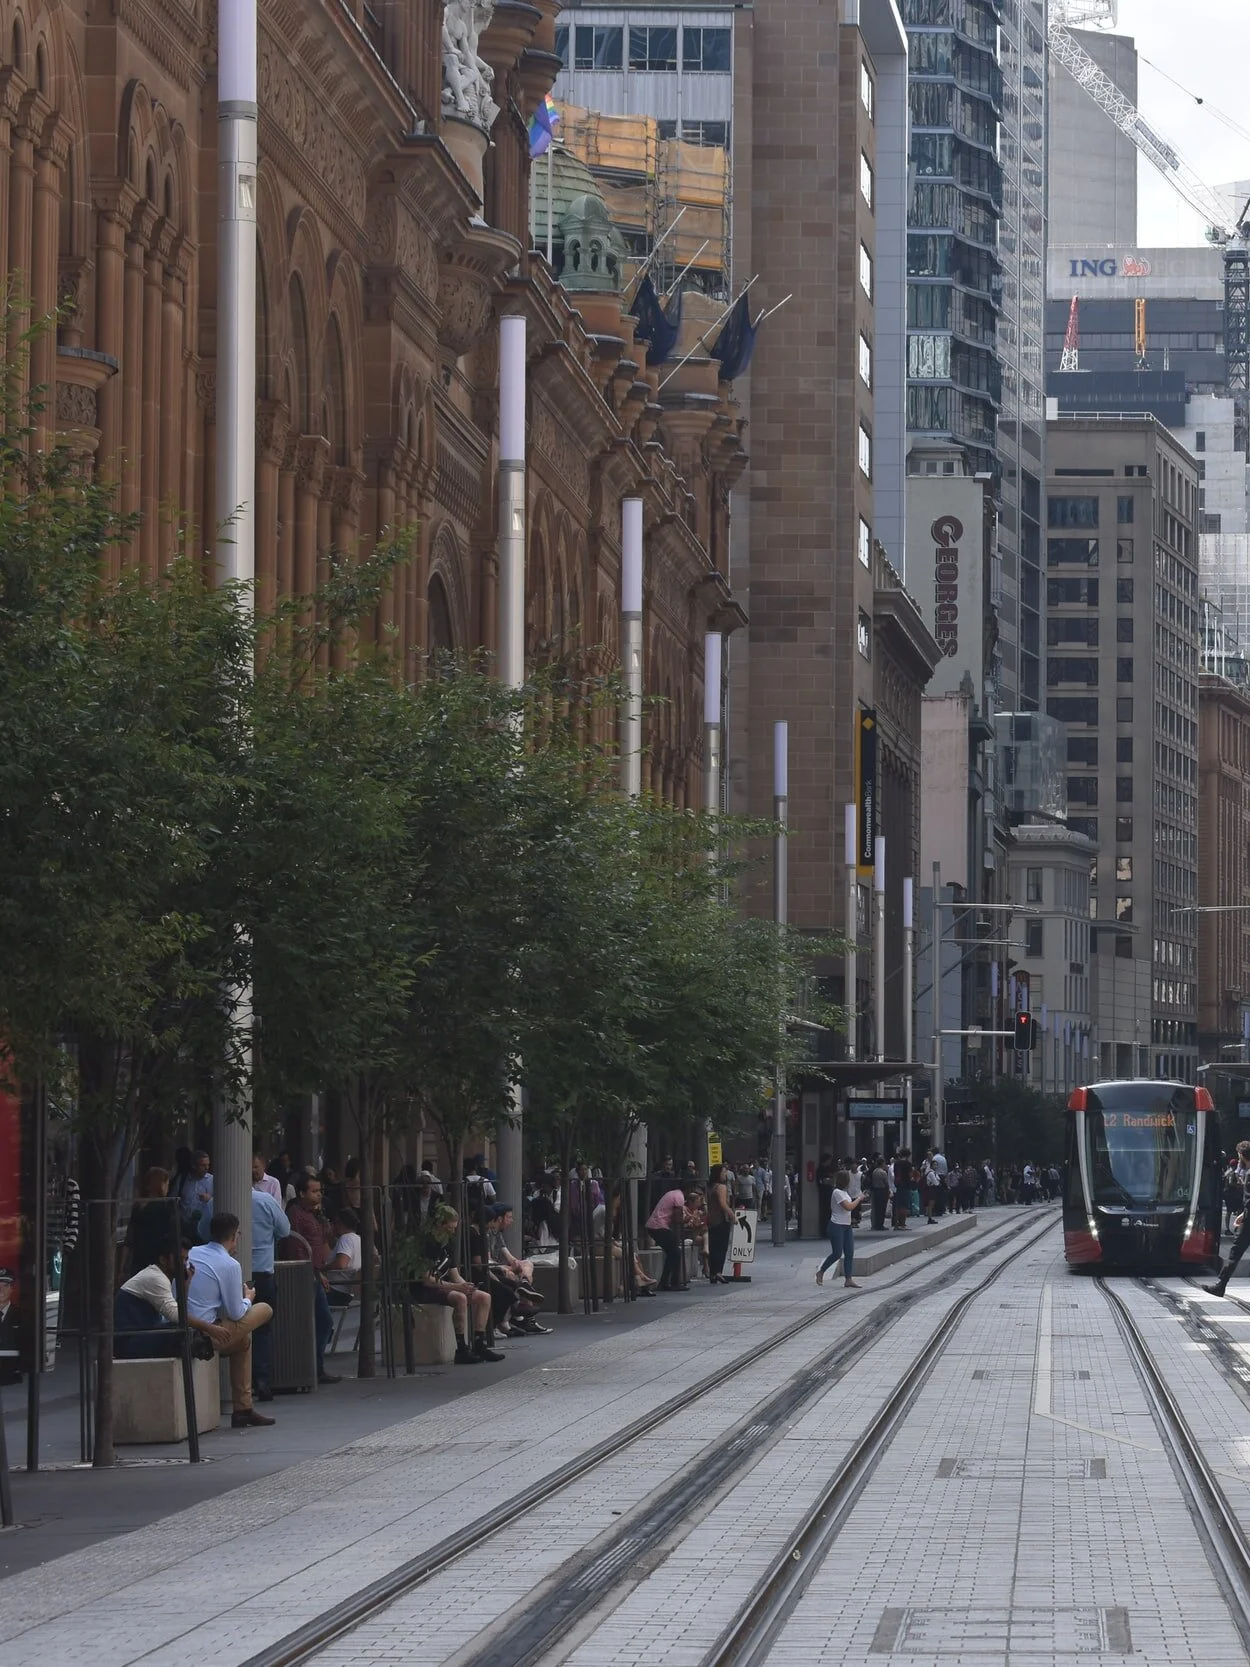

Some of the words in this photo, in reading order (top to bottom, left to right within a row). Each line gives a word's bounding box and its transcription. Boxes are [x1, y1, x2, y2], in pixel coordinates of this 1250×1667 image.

[1069, 258, 1118, 278] ING
[864, 779, 872, 858] CommonwealthBank
[1103, 1113, 1117, 1127] L2
[1123, 1113, 1175, 1127] Randwick
[732, 1247, 753, 1257] ONLY
